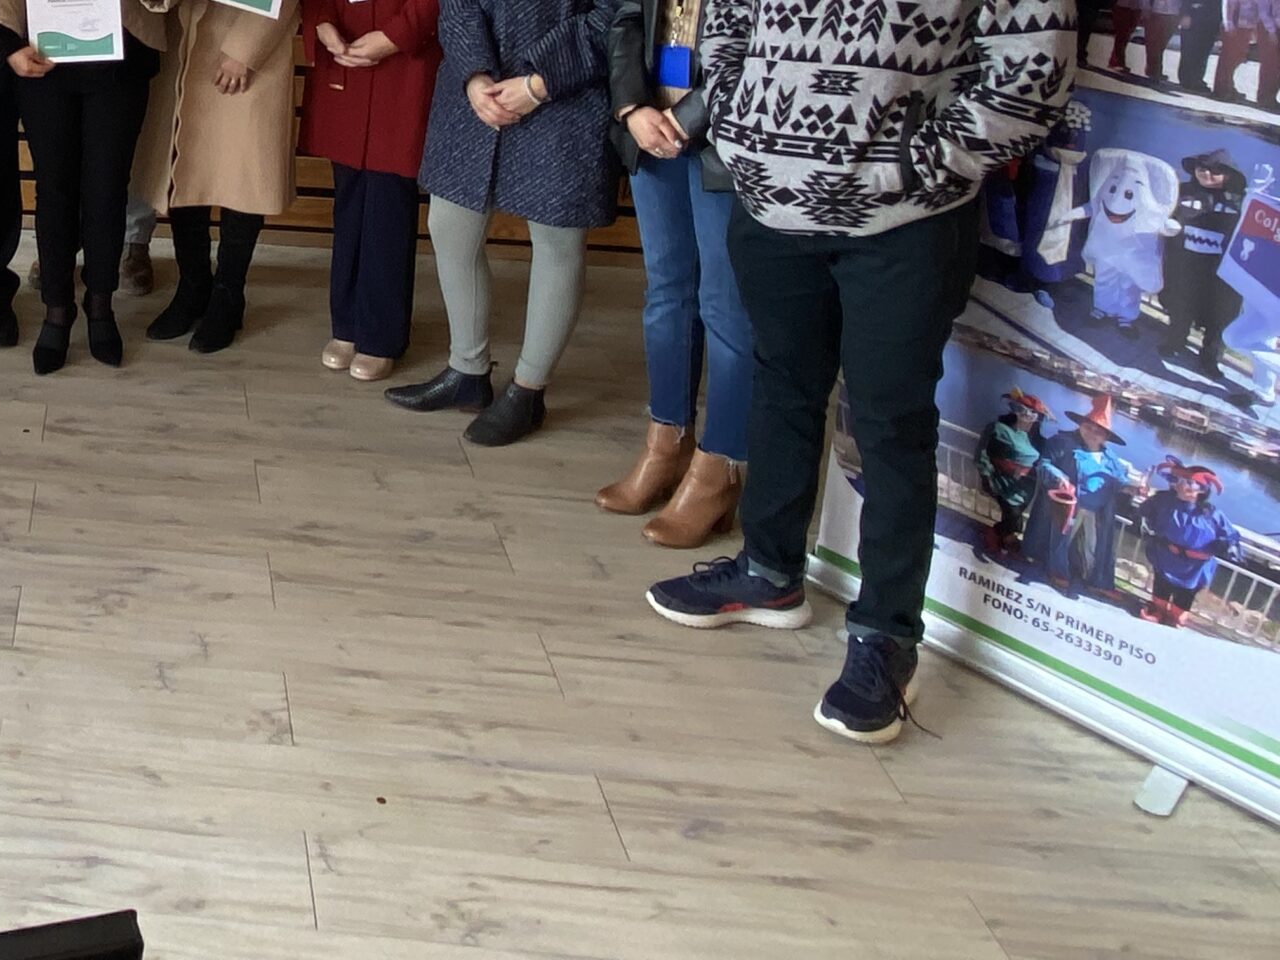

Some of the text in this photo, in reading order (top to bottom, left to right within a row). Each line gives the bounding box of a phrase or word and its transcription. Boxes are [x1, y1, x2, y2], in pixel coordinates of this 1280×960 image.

[958, 566, 1157, 666] RAMIREZ S/N PRIMER PISO
[982, 593, 1123, 667] FONO: 65-2633390
